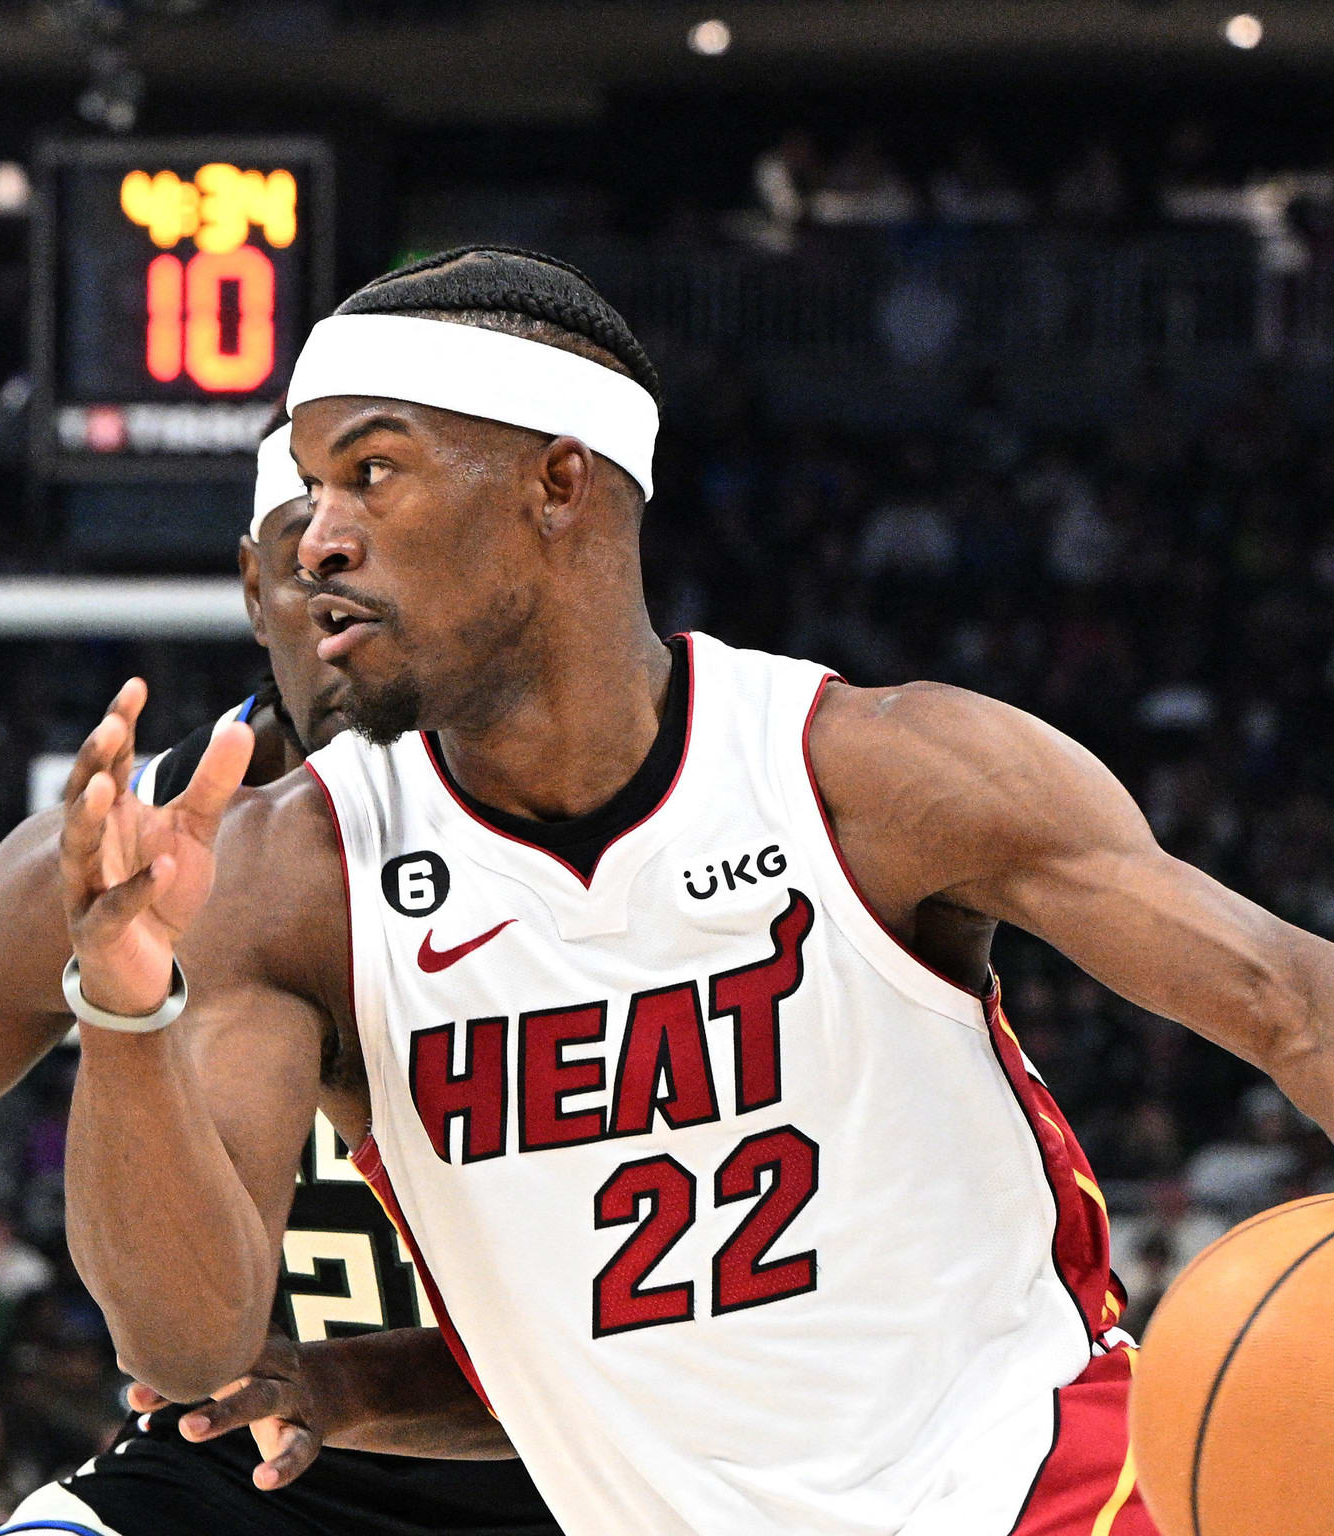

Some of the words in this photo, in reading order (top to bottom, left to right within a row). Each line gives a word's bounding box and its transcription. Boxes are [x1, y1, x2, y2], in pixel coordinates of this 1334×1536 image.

[121, 163, 297, 254] 4:34
[146, 244, 275, 392] 10
[397, 859, 436, 910] 6
[409, 887, 815, 1166] HEAT
[593, 1124, 819, 1340] 22
